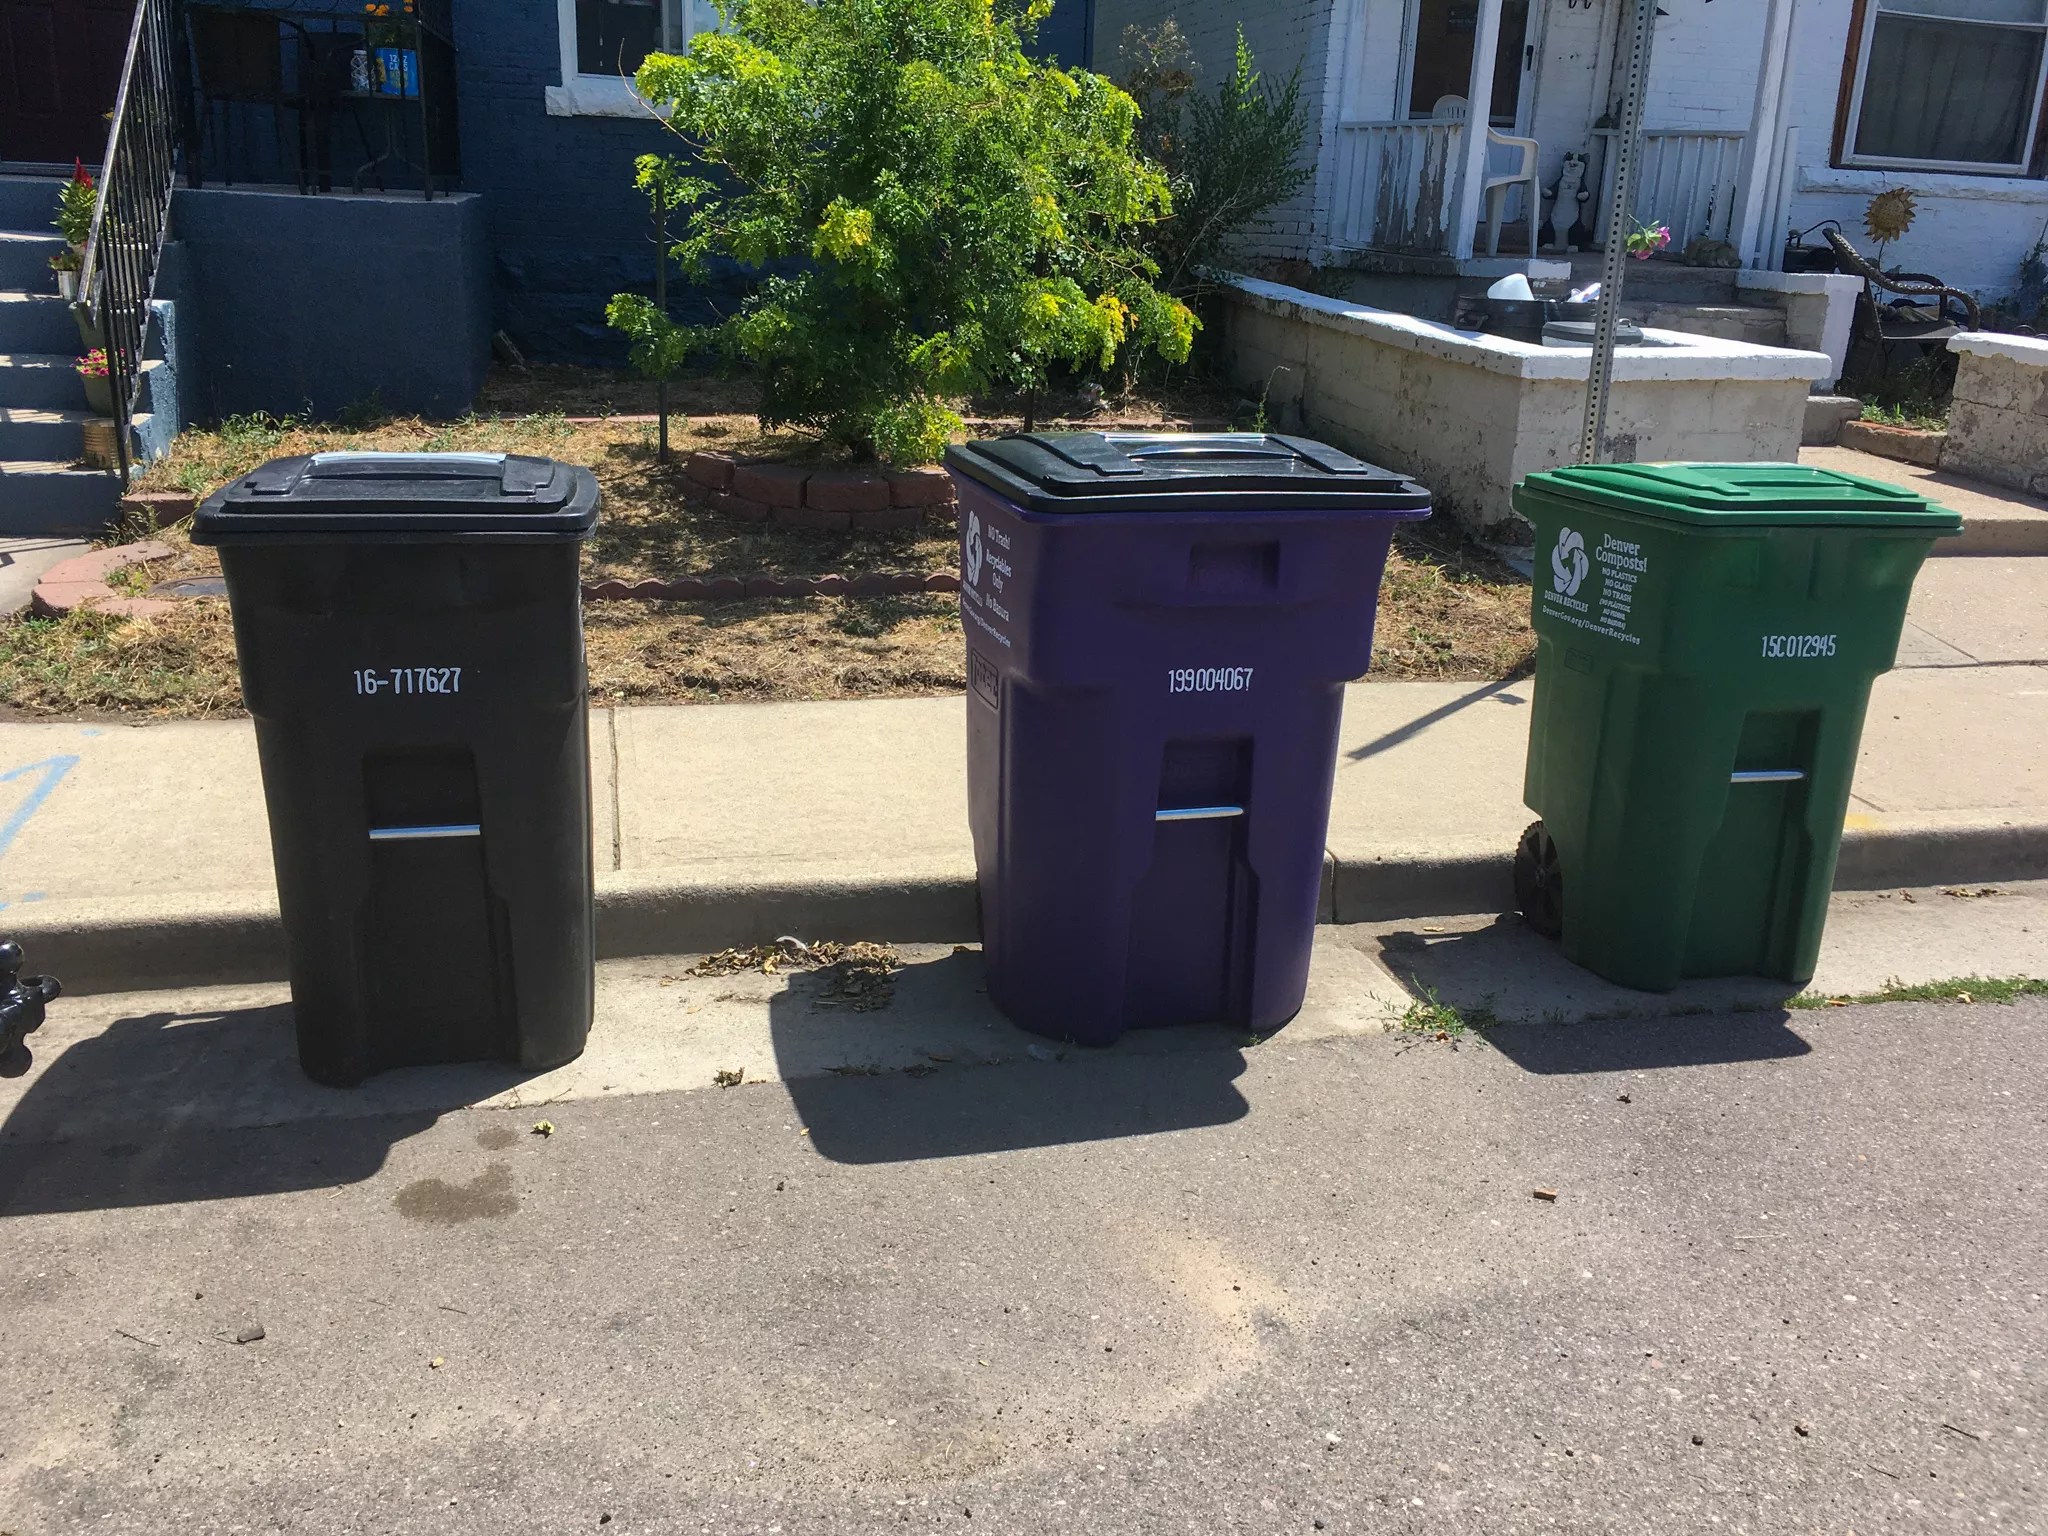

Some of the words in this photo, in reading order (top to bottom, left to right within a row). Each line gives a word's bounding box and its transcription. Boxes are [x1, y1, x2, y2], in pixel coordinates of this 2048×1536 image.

[389, 62, 408, 72] CAS
[1604, 533, 1641, 556] Denver
[1596, 546, 1648, 573] Composts!
[1602, 567, 1611, 577] NO
[1611, 569, 1638, 584] PLASTICS
[1605, 578, 1614, 588] NO
[1614, 581, 1633, 593] GLASS
[1544, 590, 1563, 605] DENVER
[1563, 595, 1589, 613] RECYCLES
[1603, 588, 1612, 597] NO
[1612, 590, 1632, 603] TRASH
[1542, 605, 1641, 645] DenverGov.org/DenverRecycles
[1761, 634, 1837, 658] 15C012945
[353, 667, 462, 695] 16-717627
[1168, 666, 1254, 693] 199004067
